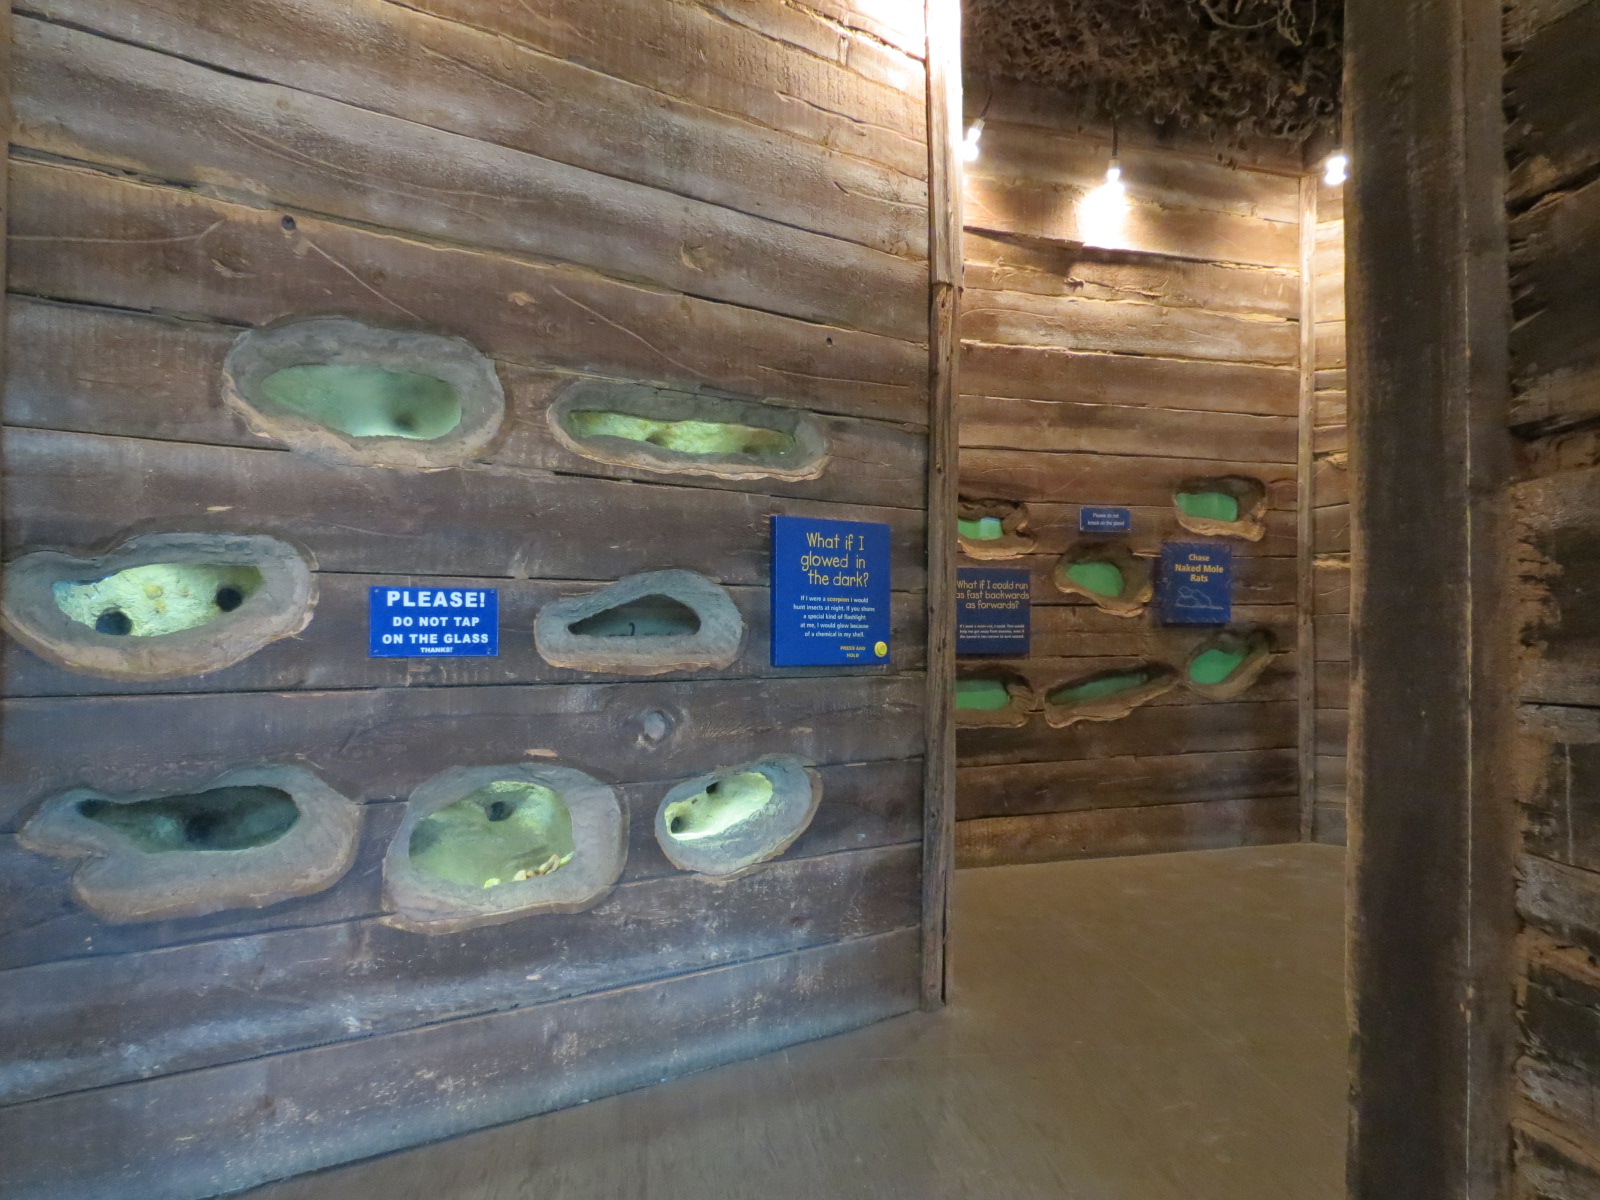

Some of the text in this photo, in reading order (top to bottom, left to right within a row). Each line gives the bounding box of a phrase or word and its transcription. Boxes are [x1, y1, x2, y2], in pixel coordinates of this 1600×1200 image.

[806, 532, 864, 550] What if I
[800, 550, 866, 572] glowed in
[1175, 564, 1224, 573] Naked Mole
[808, 570, 869, 587] the dark?
[1190, 574, 1208, 582] Rats
[957, 580, 977, 589] What
[980, 580, 985, 589] if
[992, 581, 1014, 589] could
[387, 591, 485, 608] PLEASE!
[966, 590, 983, 599] fast
[985, 590, 1030, 599] backwards
[978, 600, 1020, 609] forwards?
[392, 616, 480, 626] DO NOT TAP
[382, 634, 489, 644] ON THE GLASS
